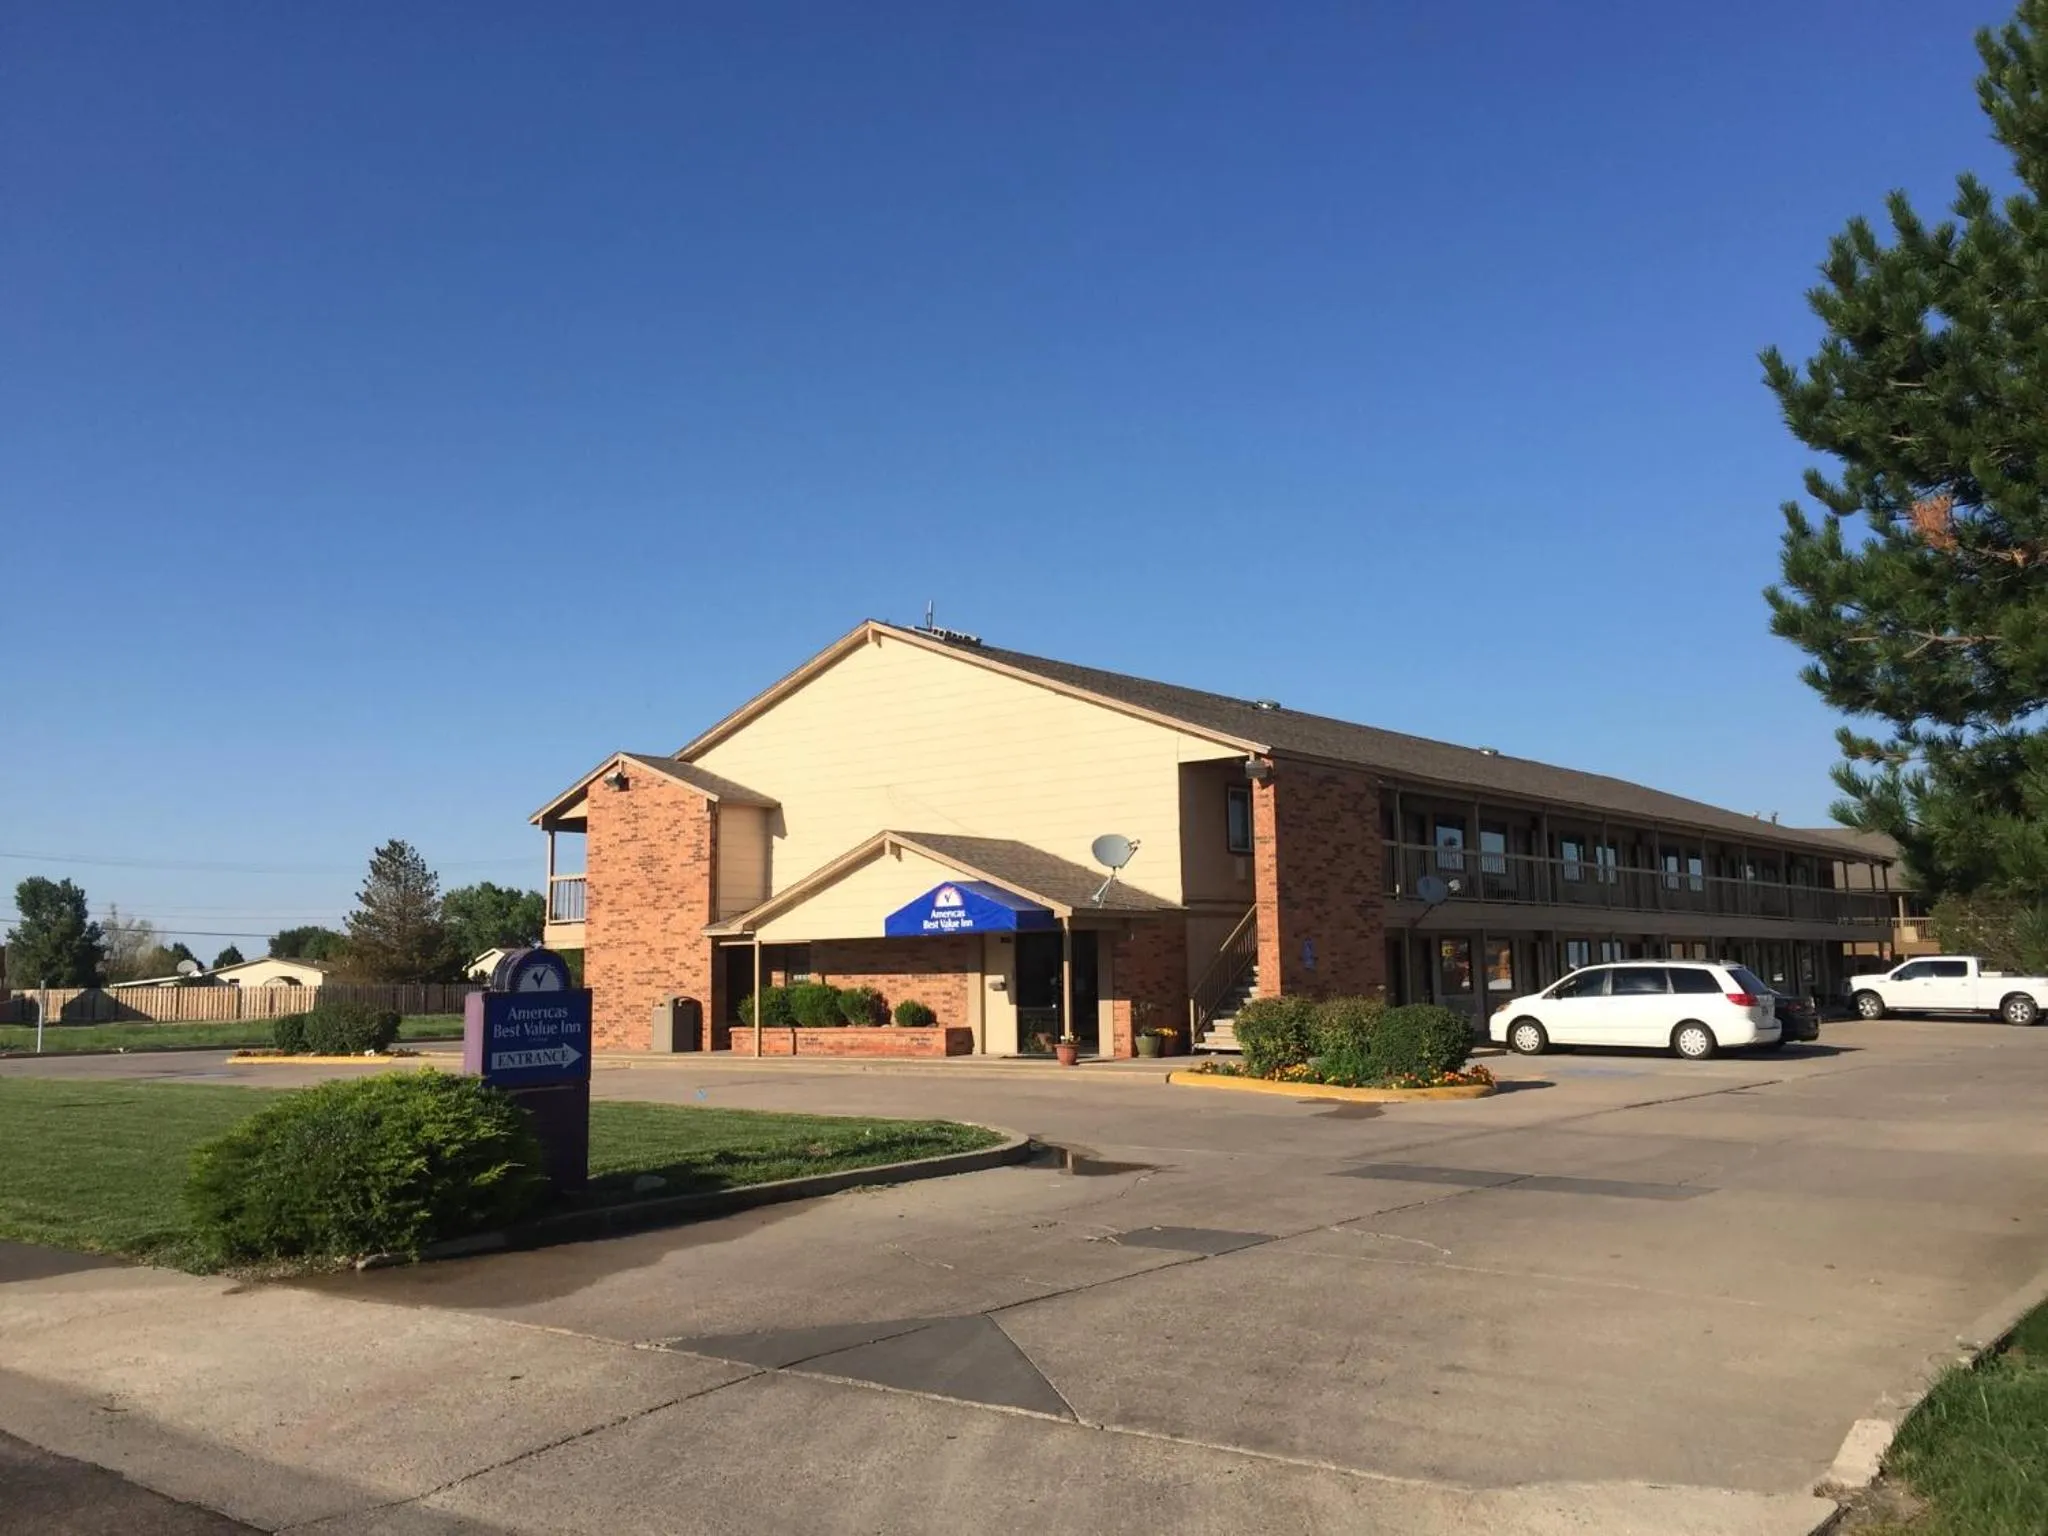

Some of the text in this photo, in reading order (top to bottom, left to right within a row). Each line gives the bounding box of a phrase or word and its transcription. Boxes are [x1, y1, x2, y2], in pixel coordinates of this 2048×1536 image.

[922, 918, 973, 929] Best Value Inn
[508, 1006, 568, 1020] Americas
[493, 1019, 582, 1038] Best Value Inn
[497, 1050, 569, 1067] ENTRANCE
